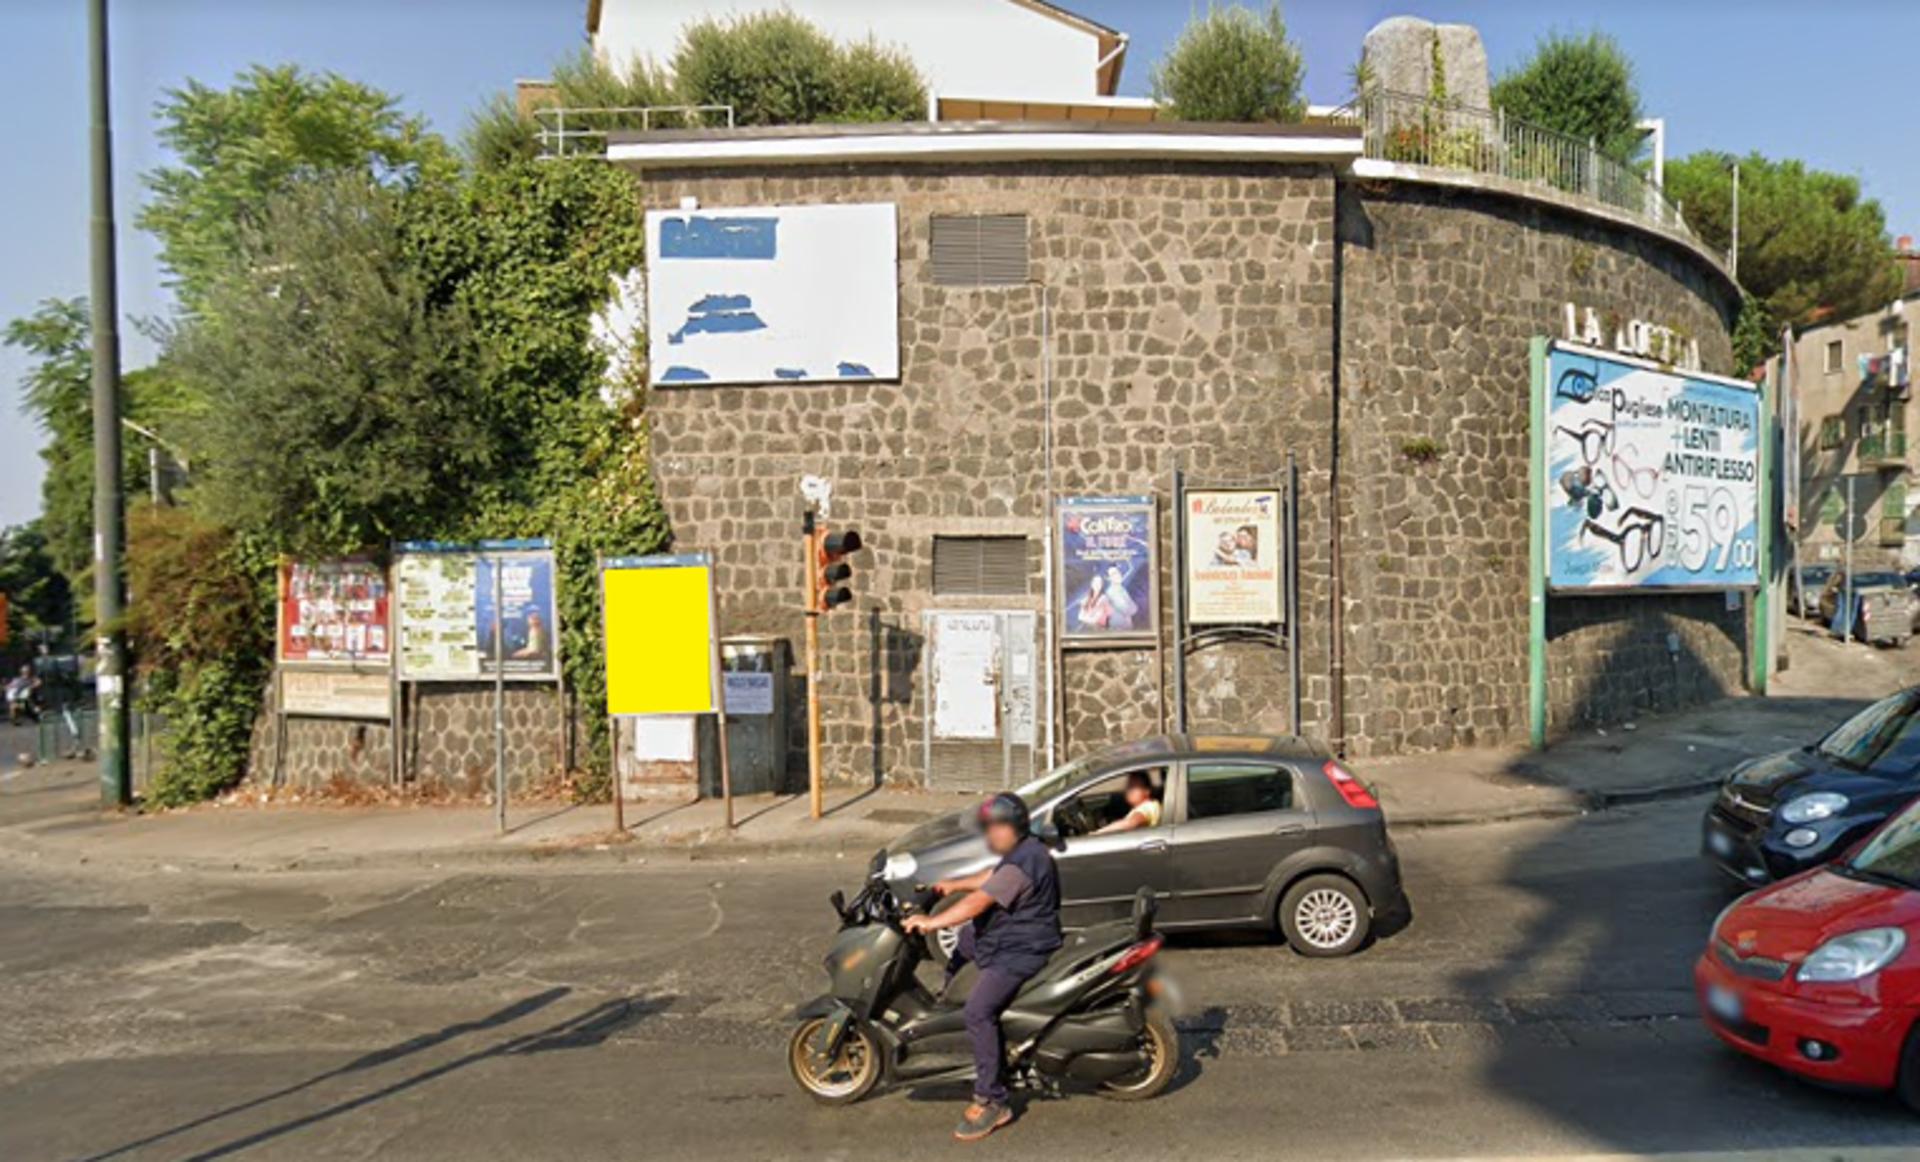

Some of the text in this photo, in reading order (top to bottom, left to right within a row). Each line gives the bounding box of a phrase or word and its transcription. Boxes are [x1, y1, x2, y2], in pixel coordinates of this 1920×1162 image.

[1563, 302, 1601, 347] LA
[1667, 398, 1750, 430] MONTATURA
[1663, 452, 1755, 482] ANTIRIFLESSO
